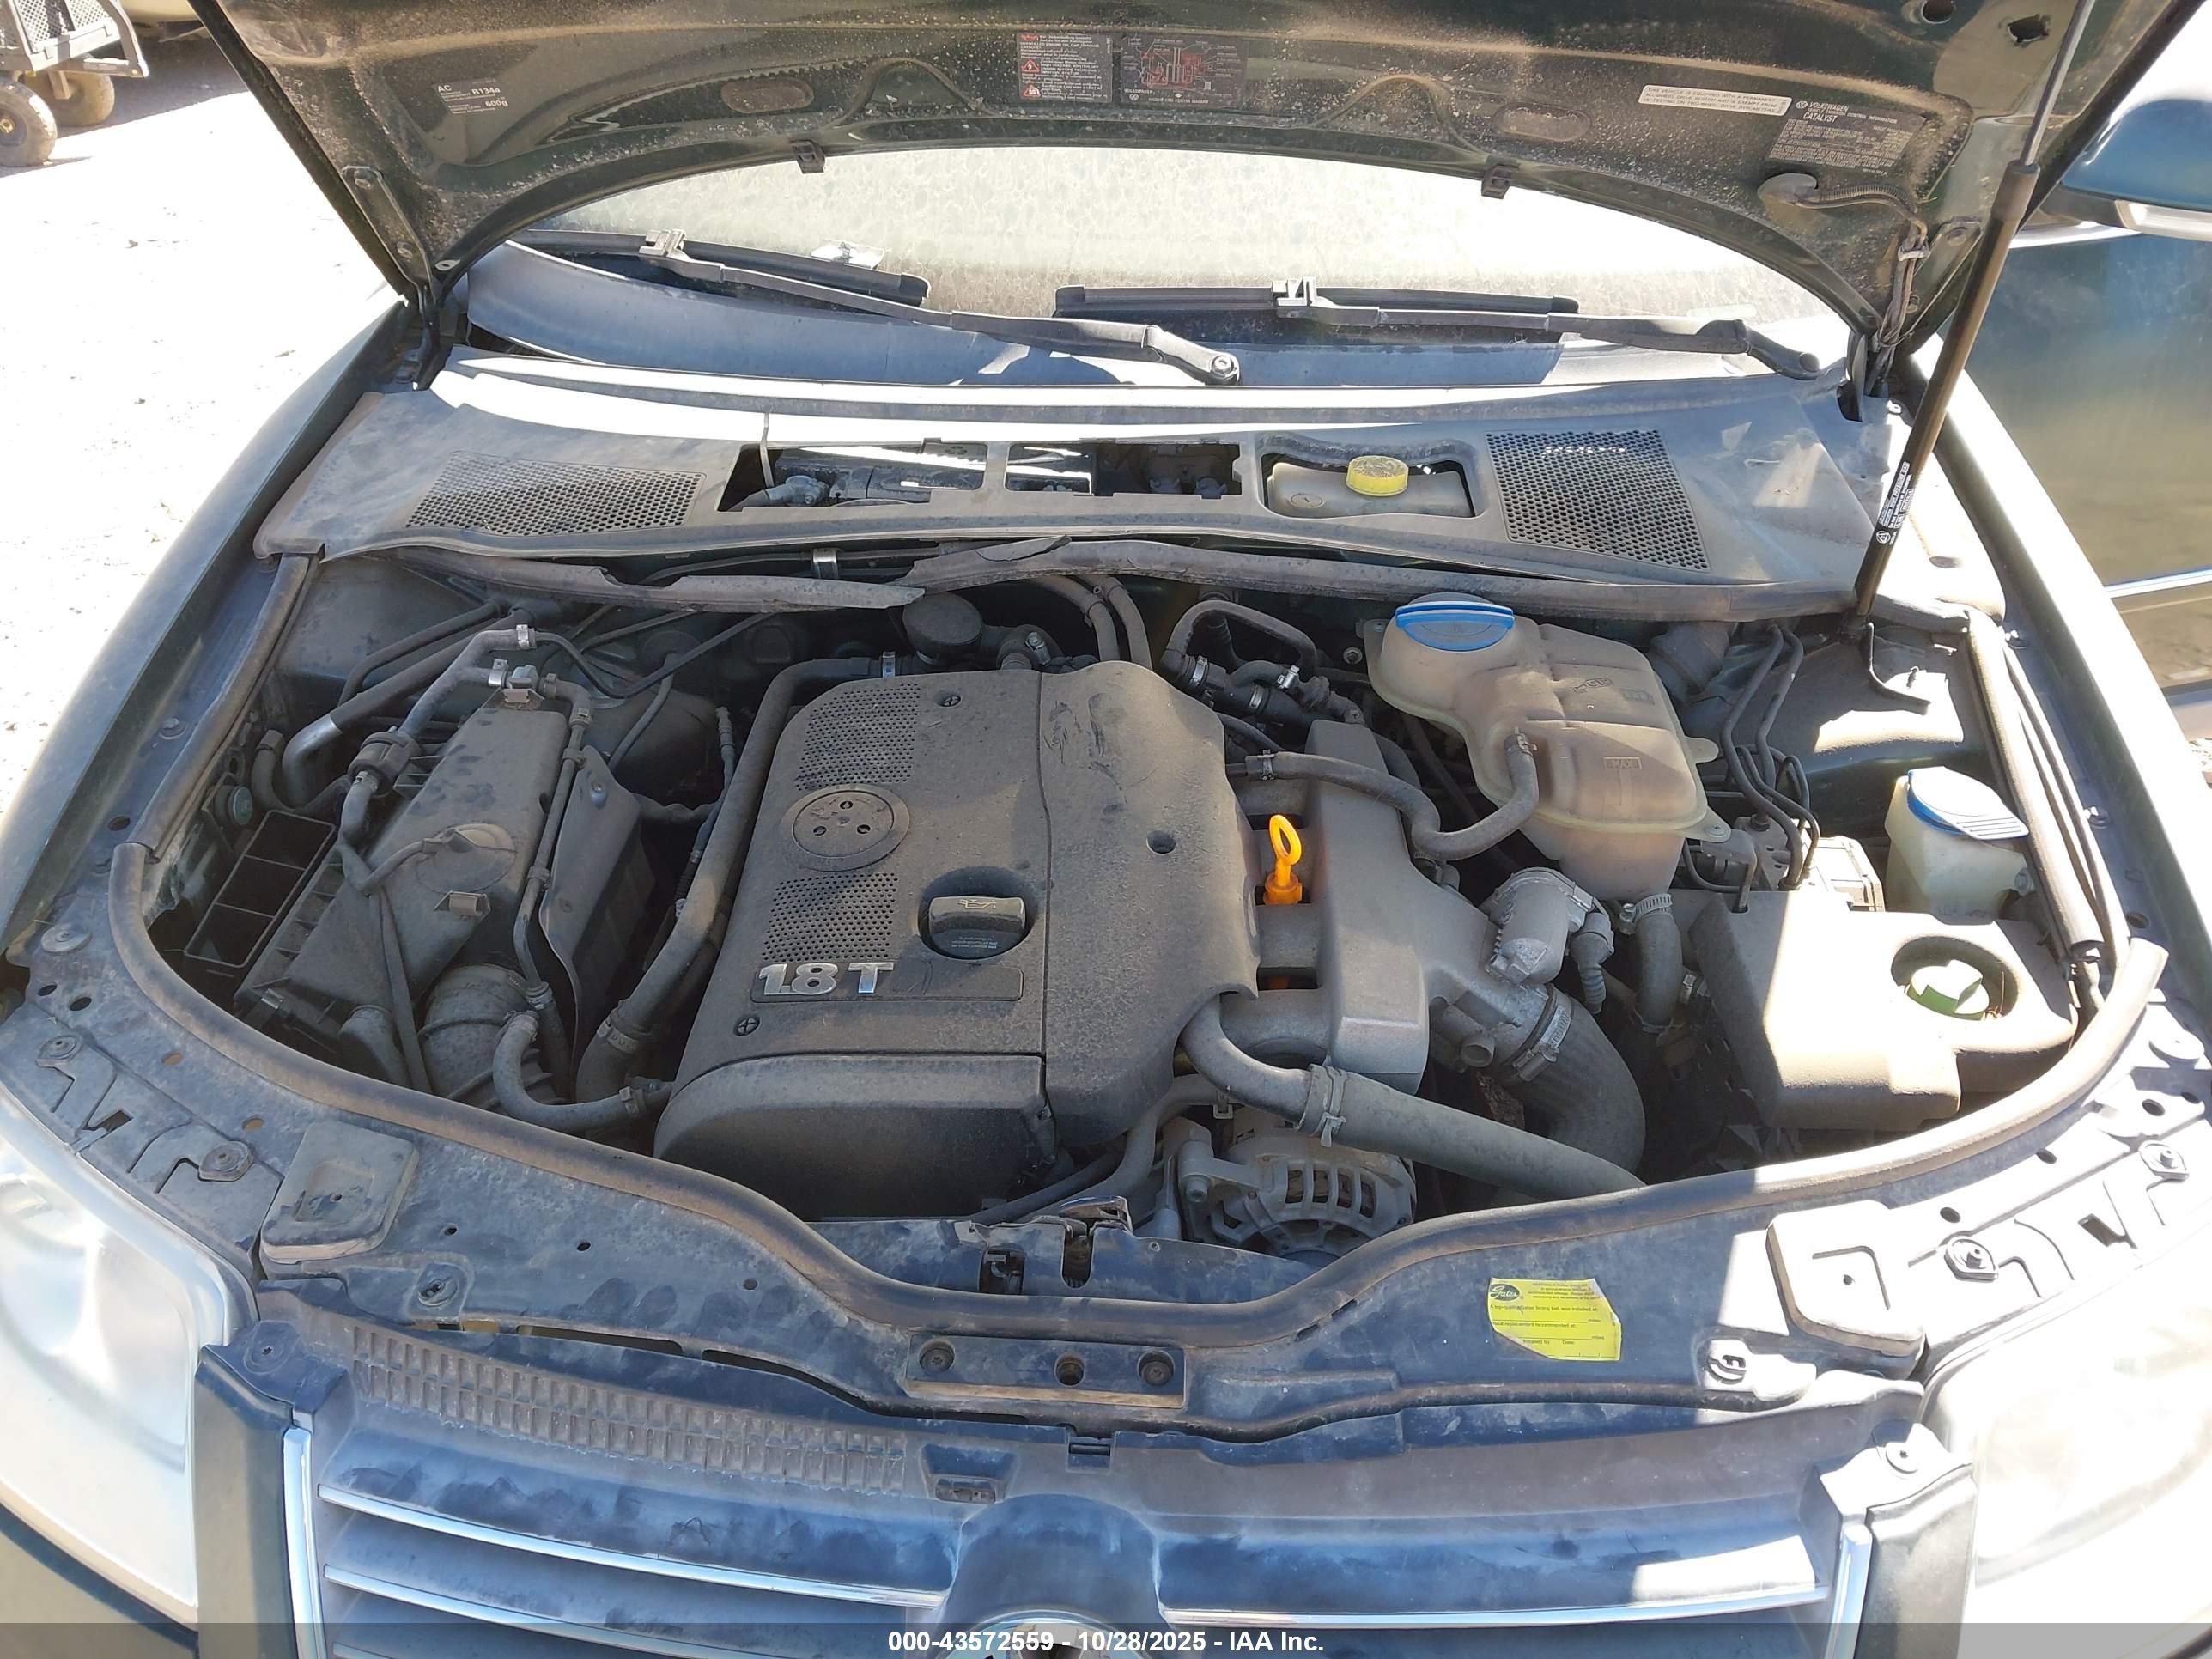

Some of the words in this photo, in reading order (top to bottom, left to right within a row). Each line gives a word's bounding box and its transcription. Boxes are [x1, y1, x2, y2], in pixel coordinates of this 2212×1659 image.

[1809, 102, 1850, 113] VOLKSWAGEN
[1803, 112, 1838, 123] CATALYST
[848, 962, 894, 994] T
[1490, 1285, 1518, 1298] Gates
